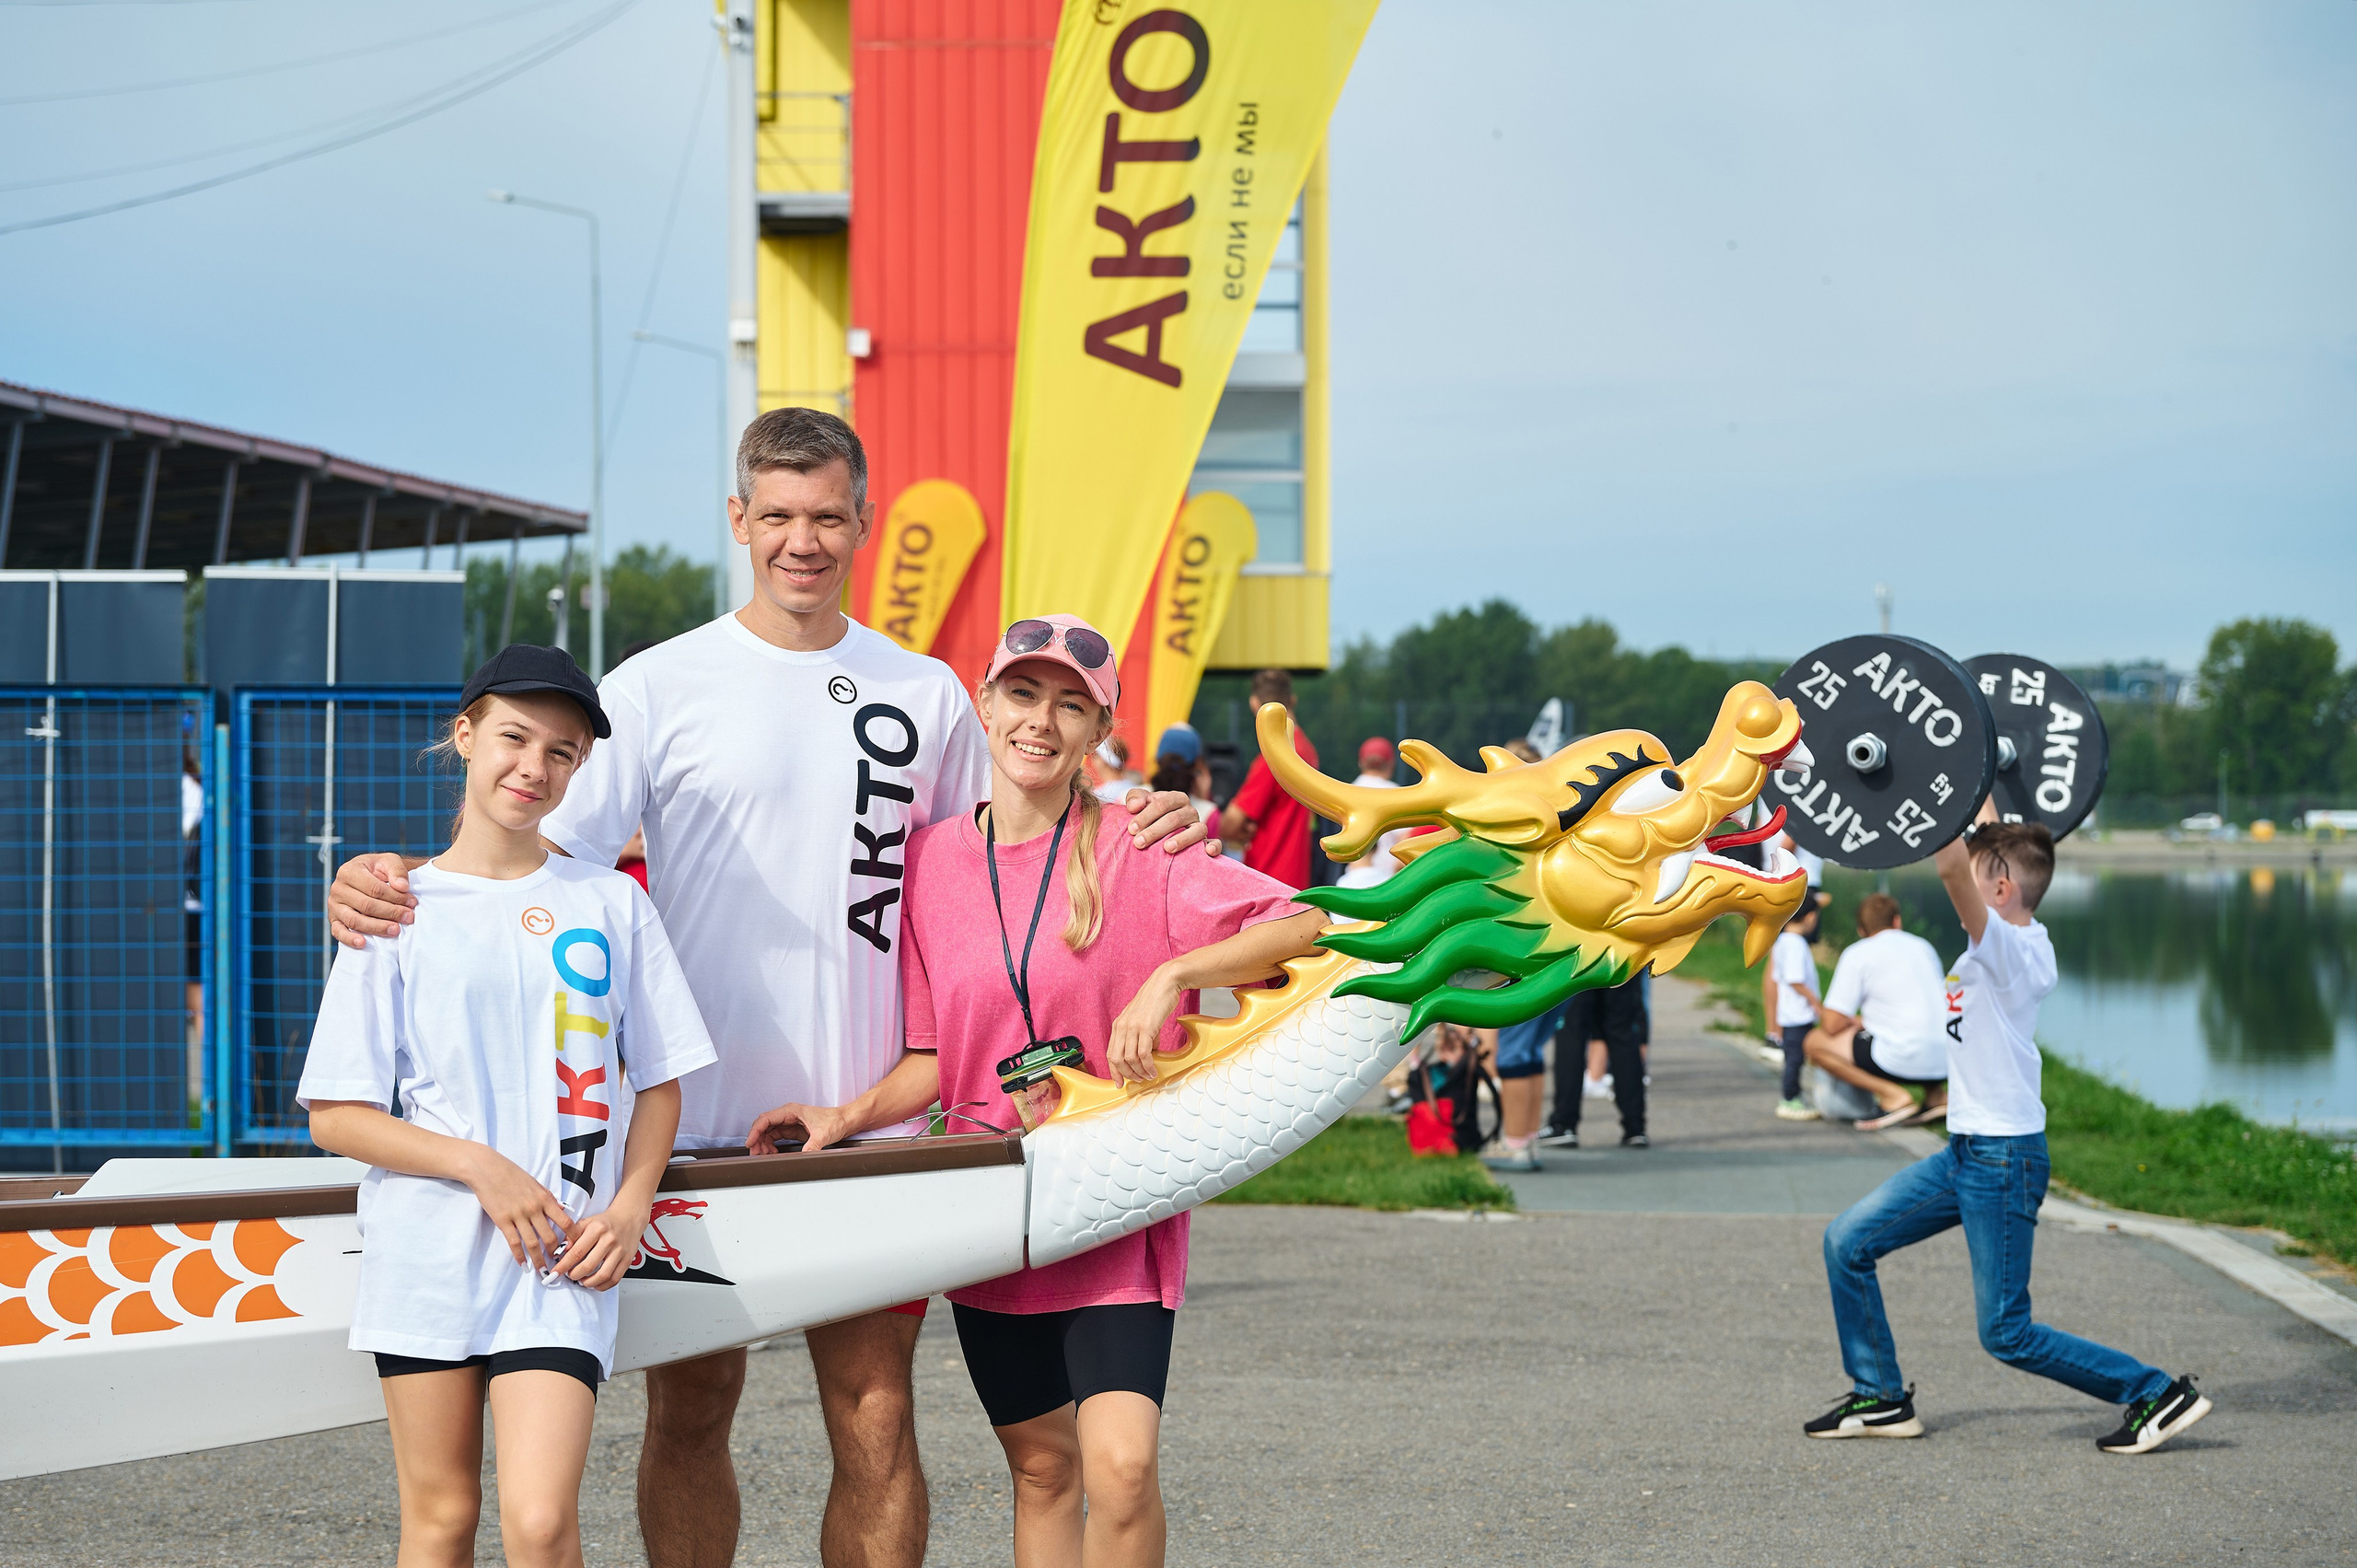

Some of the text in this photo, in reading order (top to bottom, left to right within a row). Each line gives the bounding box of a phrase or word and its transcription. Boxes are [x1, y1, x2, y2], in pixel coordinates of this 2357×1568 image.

[1084, 9, 1210, 389] АКТО
[1222, 101, 1260, 301] если не мы
[883, 522, 935, 644] АКТО
[1164, 534, 1212, 657] АКТО
[1797, 660, 1848, 711] 25
[1852, 651, 1963, 748] АКТО
[2010, 667, 2046, 707] 25
[1929, 772, 1954, 807] kg
[2035, 702, 2084, 814] АКТО
[847, 703, 919, 954] АКТО
[1886, 797, 1937, 849] 25
[552, 927, 612, 1200] АКТО
